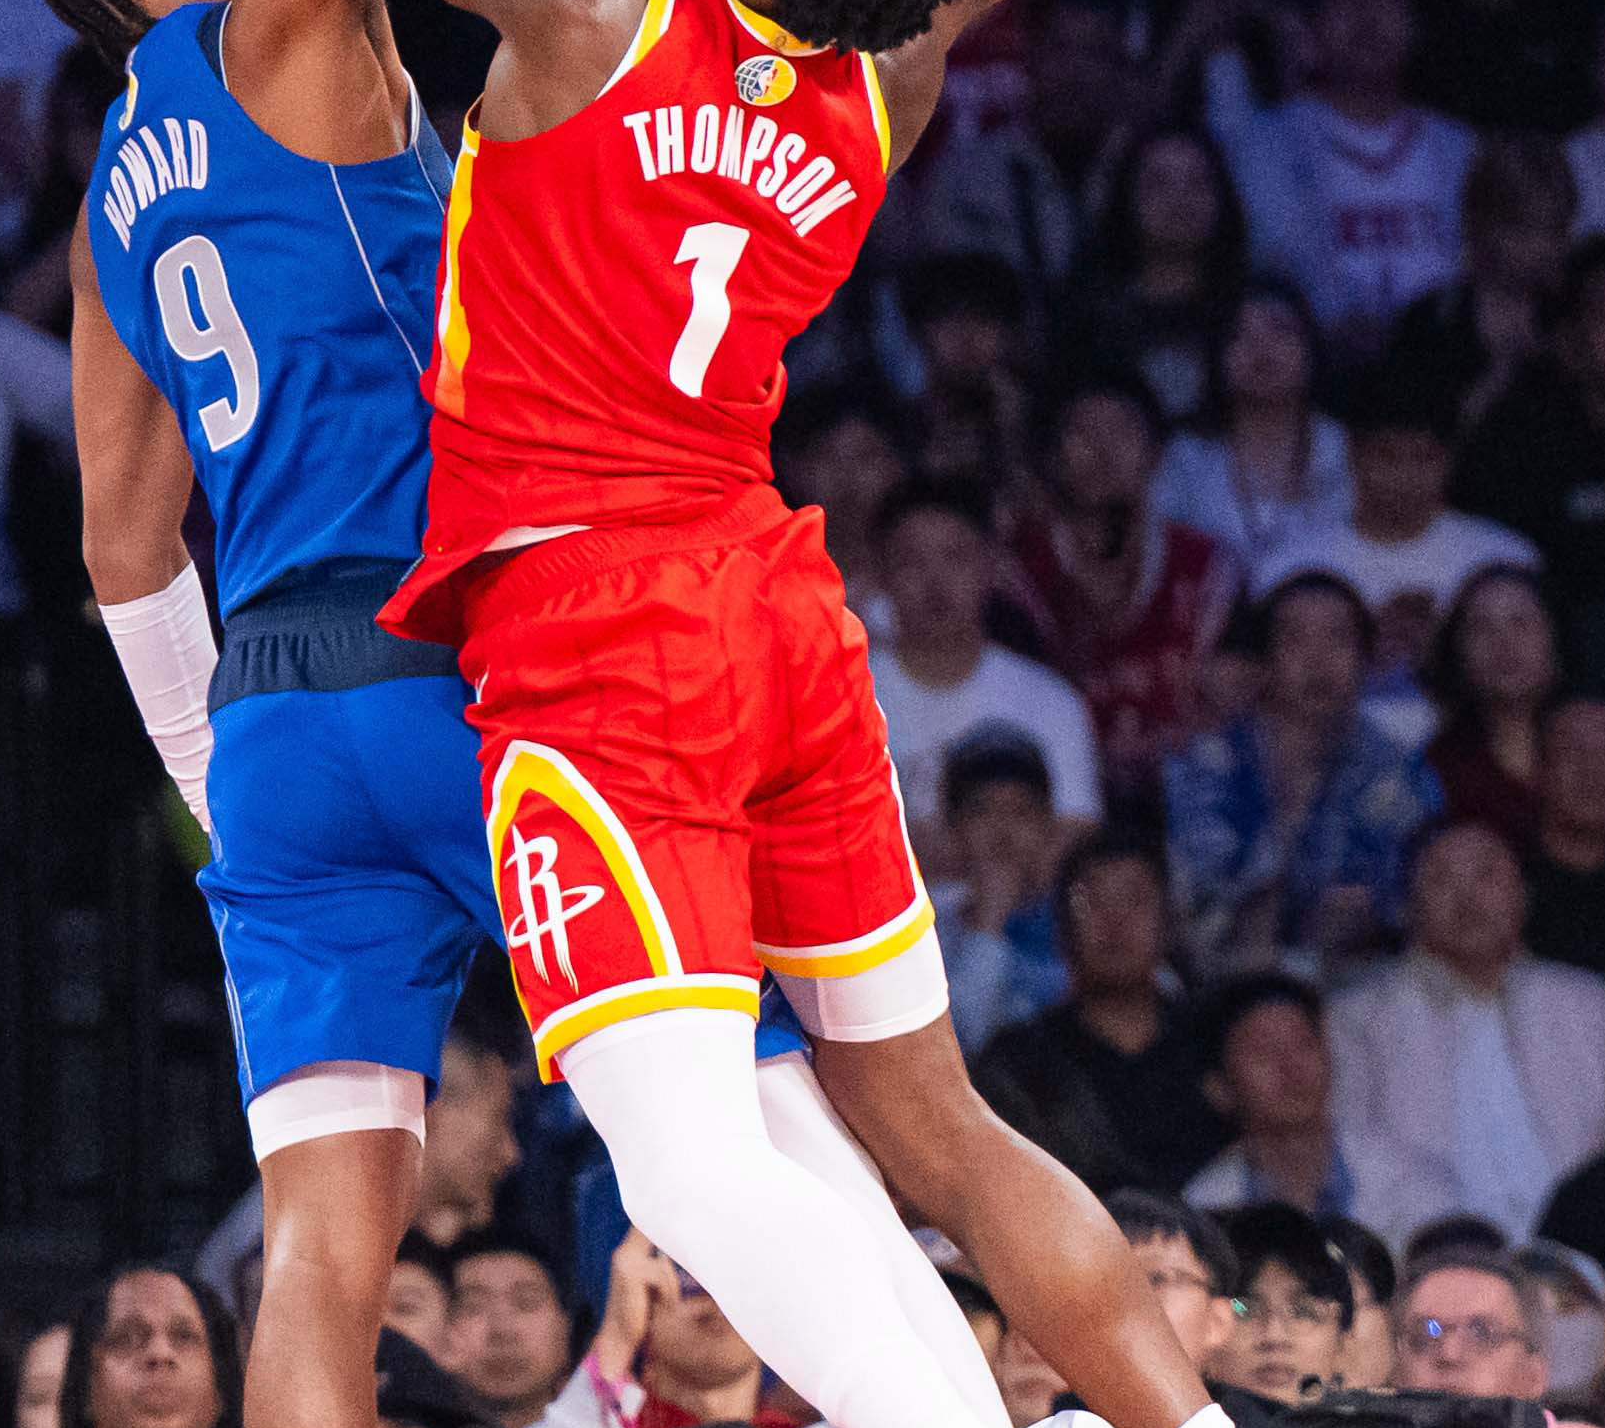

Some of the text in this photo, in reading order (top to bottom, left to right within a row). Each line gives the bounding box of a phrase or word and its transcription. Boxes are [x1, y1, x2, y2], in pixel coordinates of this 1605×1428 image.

[103, 117, 209, 253] HOWARD
[153, 234, 260, 453] 9
[668, 221, 751, 398] 1
